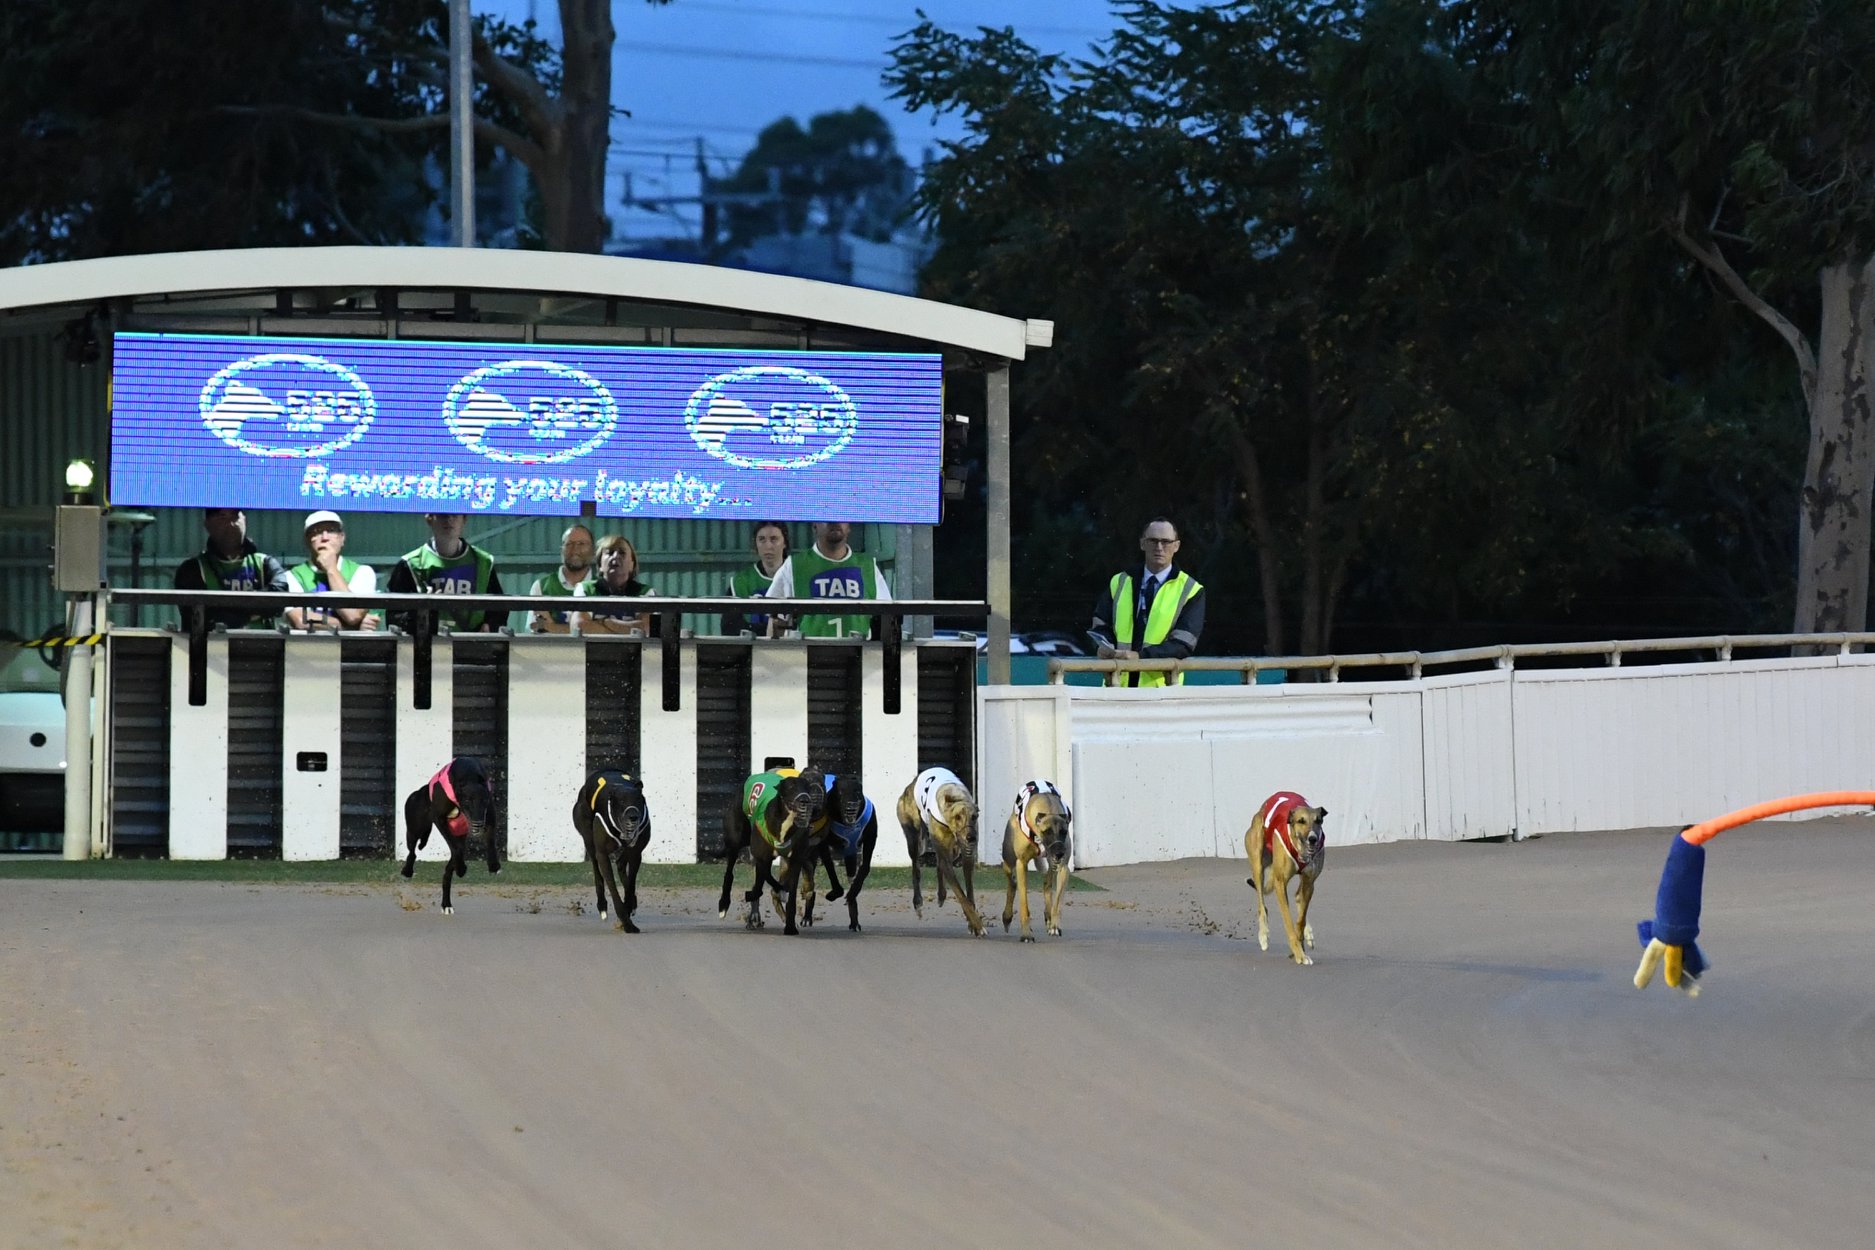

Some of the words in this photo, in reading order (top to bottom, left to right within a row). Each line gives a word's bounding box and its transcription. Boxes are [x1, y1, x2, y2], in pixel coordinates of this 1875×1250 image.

[301, 464, 497, 509] Rewarding
[499, 477, 588, 509] your
[814, 578, 860, 598] TAB
[827, 617, 843, 639] 1
